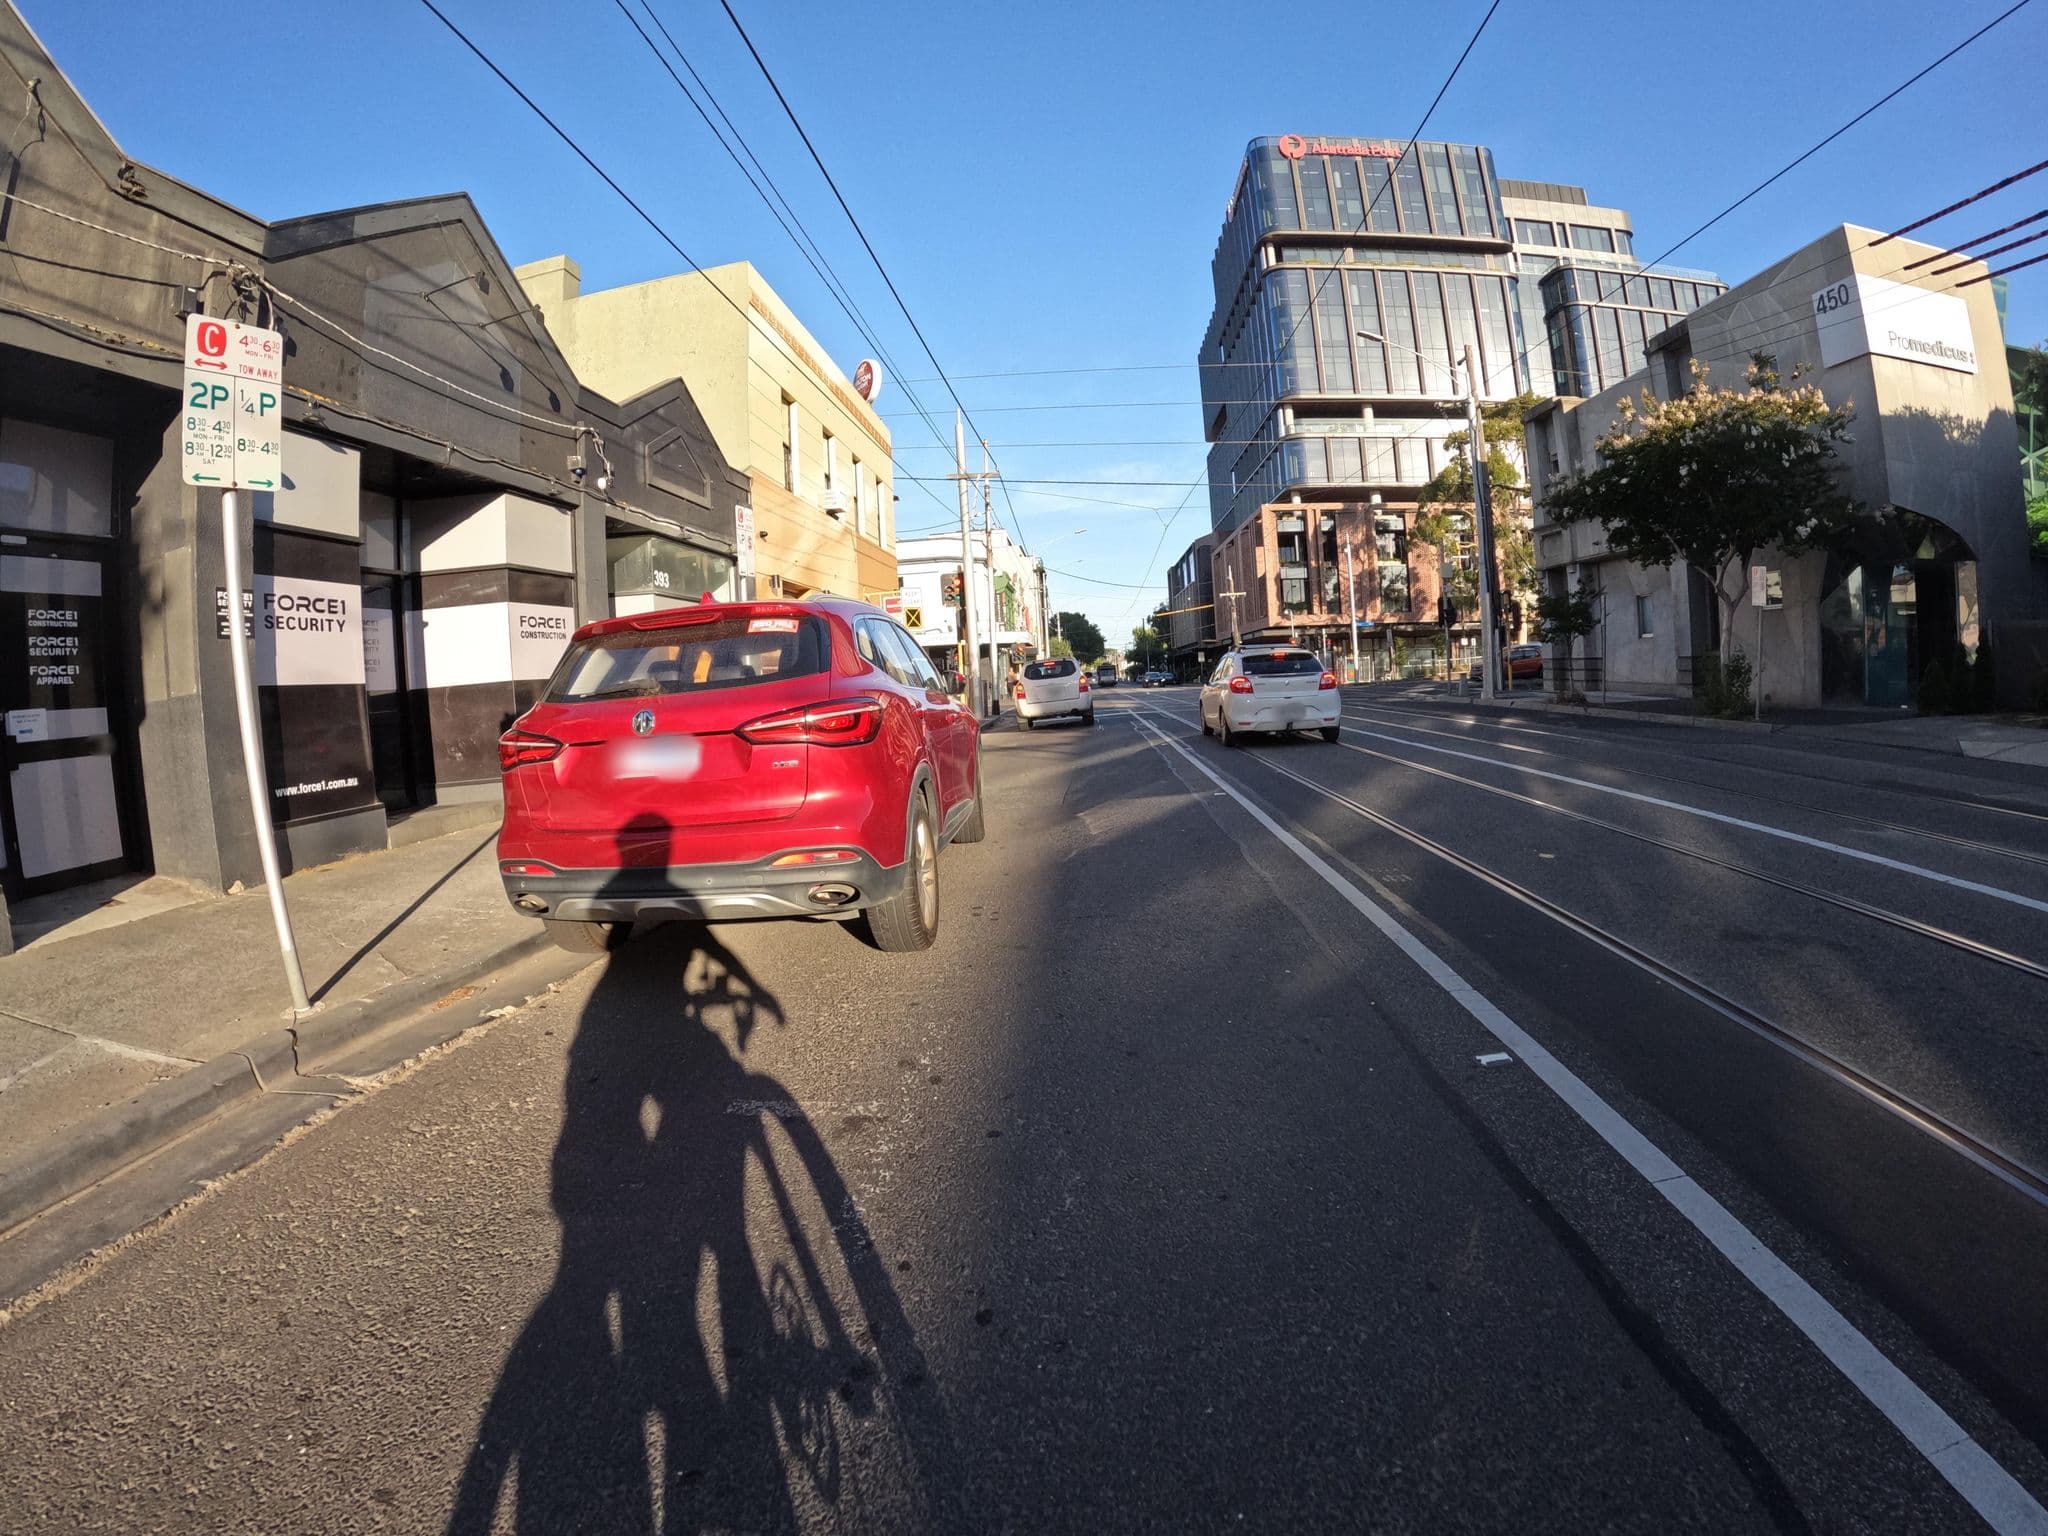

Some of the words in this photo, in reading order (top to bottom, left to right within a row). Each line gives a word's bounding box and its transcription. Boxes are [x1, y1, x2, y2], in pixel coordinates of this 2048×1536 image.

[1816, 283, 1849, 314] 450
[205, 325, 220, 354] C
[1888, 330, 1967, 362] Promedicus
[238, 363, 254, 376] TOW
[256, 367, 279, 380] AWAY
[189, 381, 230, 410] 2P
[653, 569, 670, 588] 393
[217, 591, 253, 601] FOE1
[263, 592, 346, 616] FORCE1
[28, 609, 78, 620] FORCE1
[519, 615, 566, 630] FORCE1
[28, 620, 78, 628] CONSTRUCTION
[264, 614, 346, 633] SECURITY
[28, 636, 78, 647] FORCE1
[520, 630, 567, 640] CONSTRUCTION
[29, 647, 78, 656] SECURITY
[29, 665, 80, 676] FORCE1
[36, 676, 74, 685] APPAREL
[274, 777, 359, 798] www.force1.com.au
